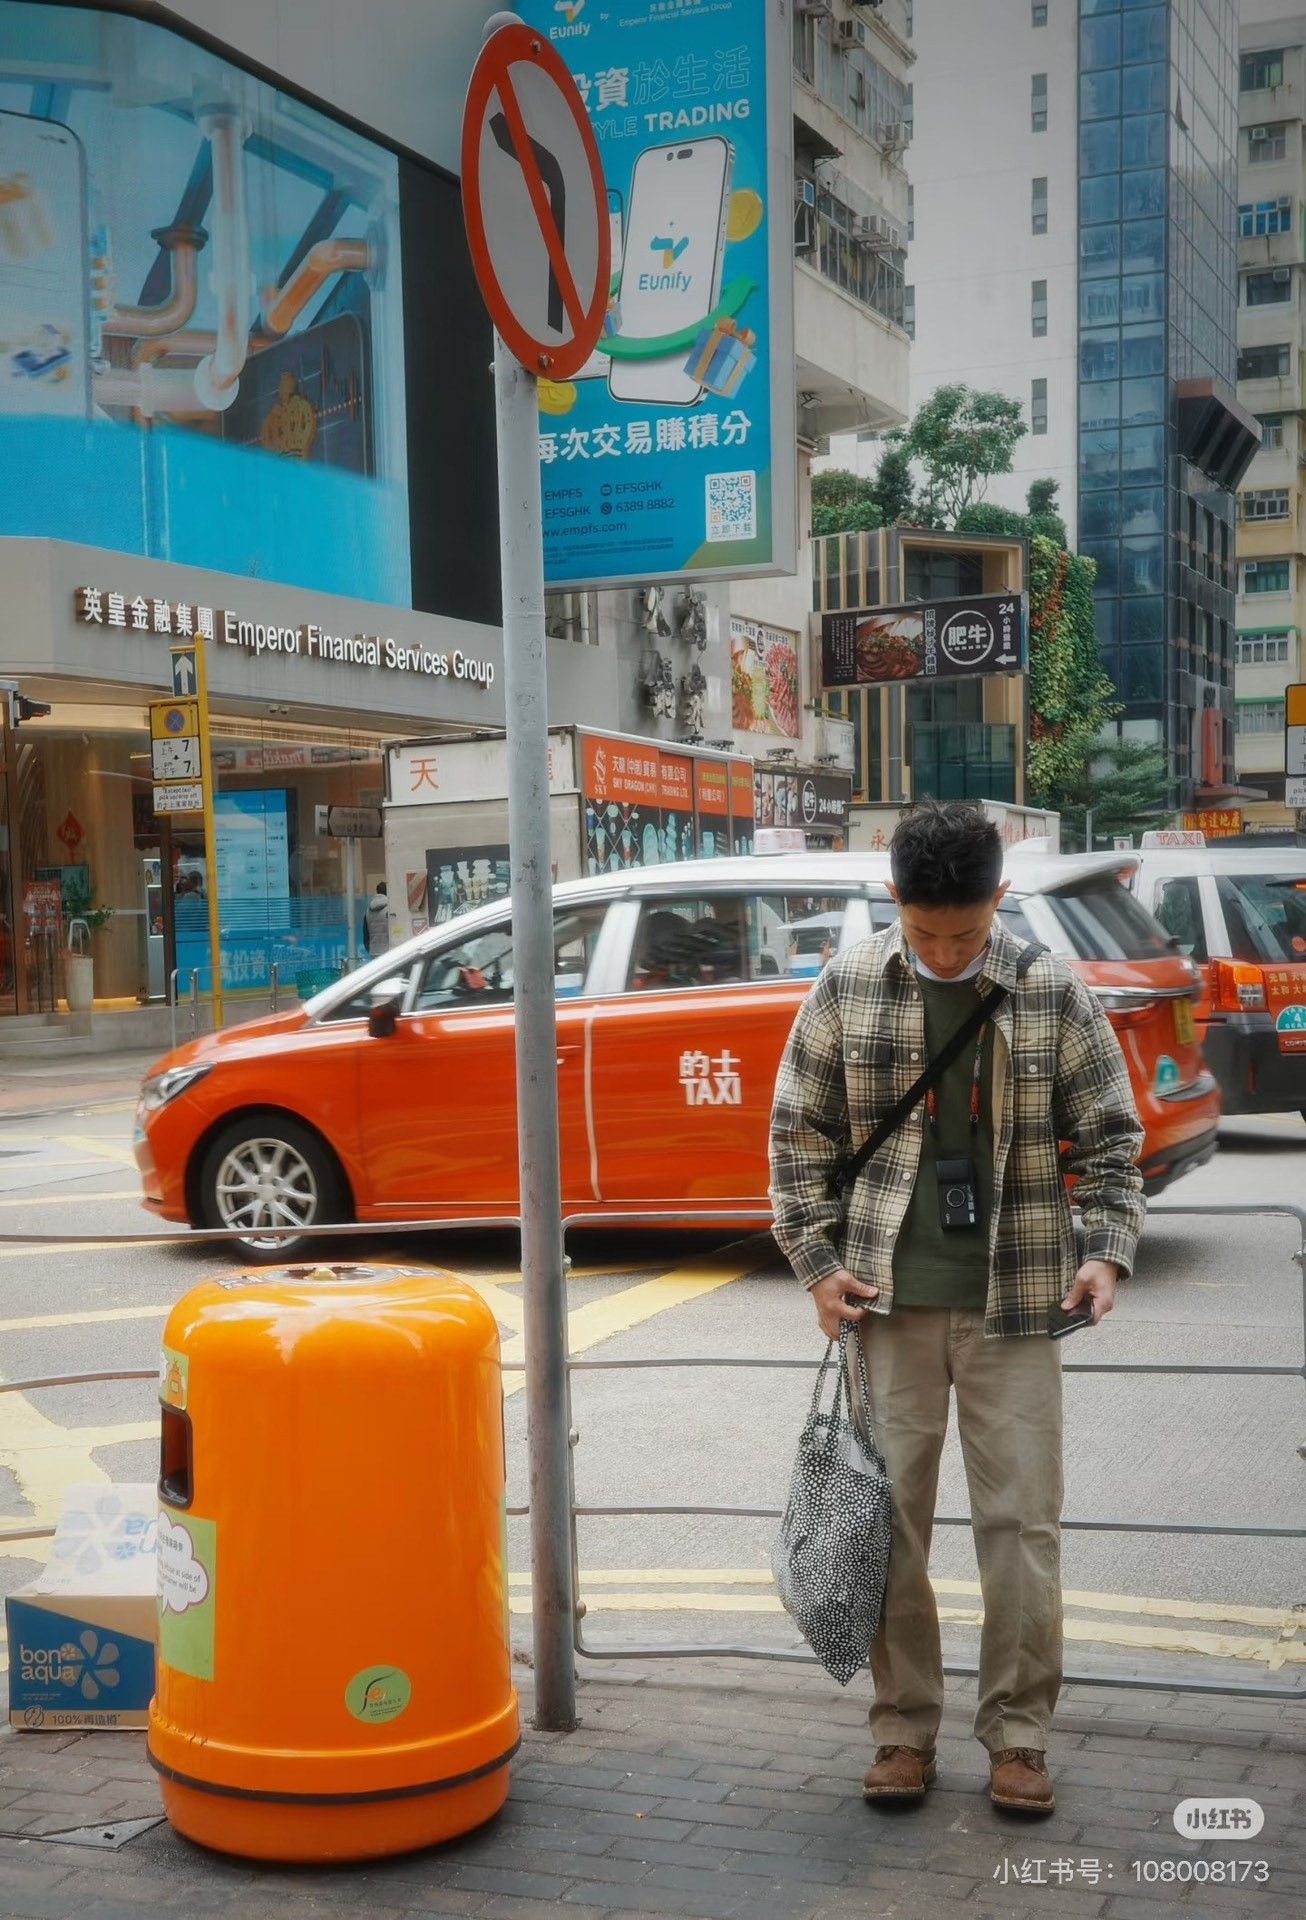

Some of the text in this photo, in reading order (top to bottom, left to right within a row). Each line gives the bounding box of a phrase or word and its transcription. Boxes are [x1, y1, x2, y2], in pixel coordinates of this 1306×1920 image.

[619, 15, 648, 27] Emperor
[649, 10, 680, 21] Financial
[681, 5, 710, 16] Services
[711, 2, 733, 11] Group
[550, 23, 591, 40] Eunify
[644, 99, 751, 132] TRADING
[639, 273, 692, 292] Eunify
[545, 488, 583, 500] EMPFS
[615, 481, 663, 495] EFSGHK
[545, 505, 591, 518] EFSGHK
[616, 498, 675, 513] 6389 8882
[999, 603, 1015, 615] 24
[81, 587, 496, 686] 英皇金融集團 Emperor Financial Services Group
[948, 624, 988, 646] 肥牛
[182, 740, 190, 752] 7
[184, 761, 191, 773] 7
[409, 758, 440, 792] 天
[1155, 831, 1205, 846] TAXI
[679, 1049, 741, 1077] 的士
[679, 1077, 742, 1105] TAXI
[20, 1644, 61, 1664] bon
[21, 1665, 75, 1685] aqua
[52, 1714, 82, 1725] 100%
